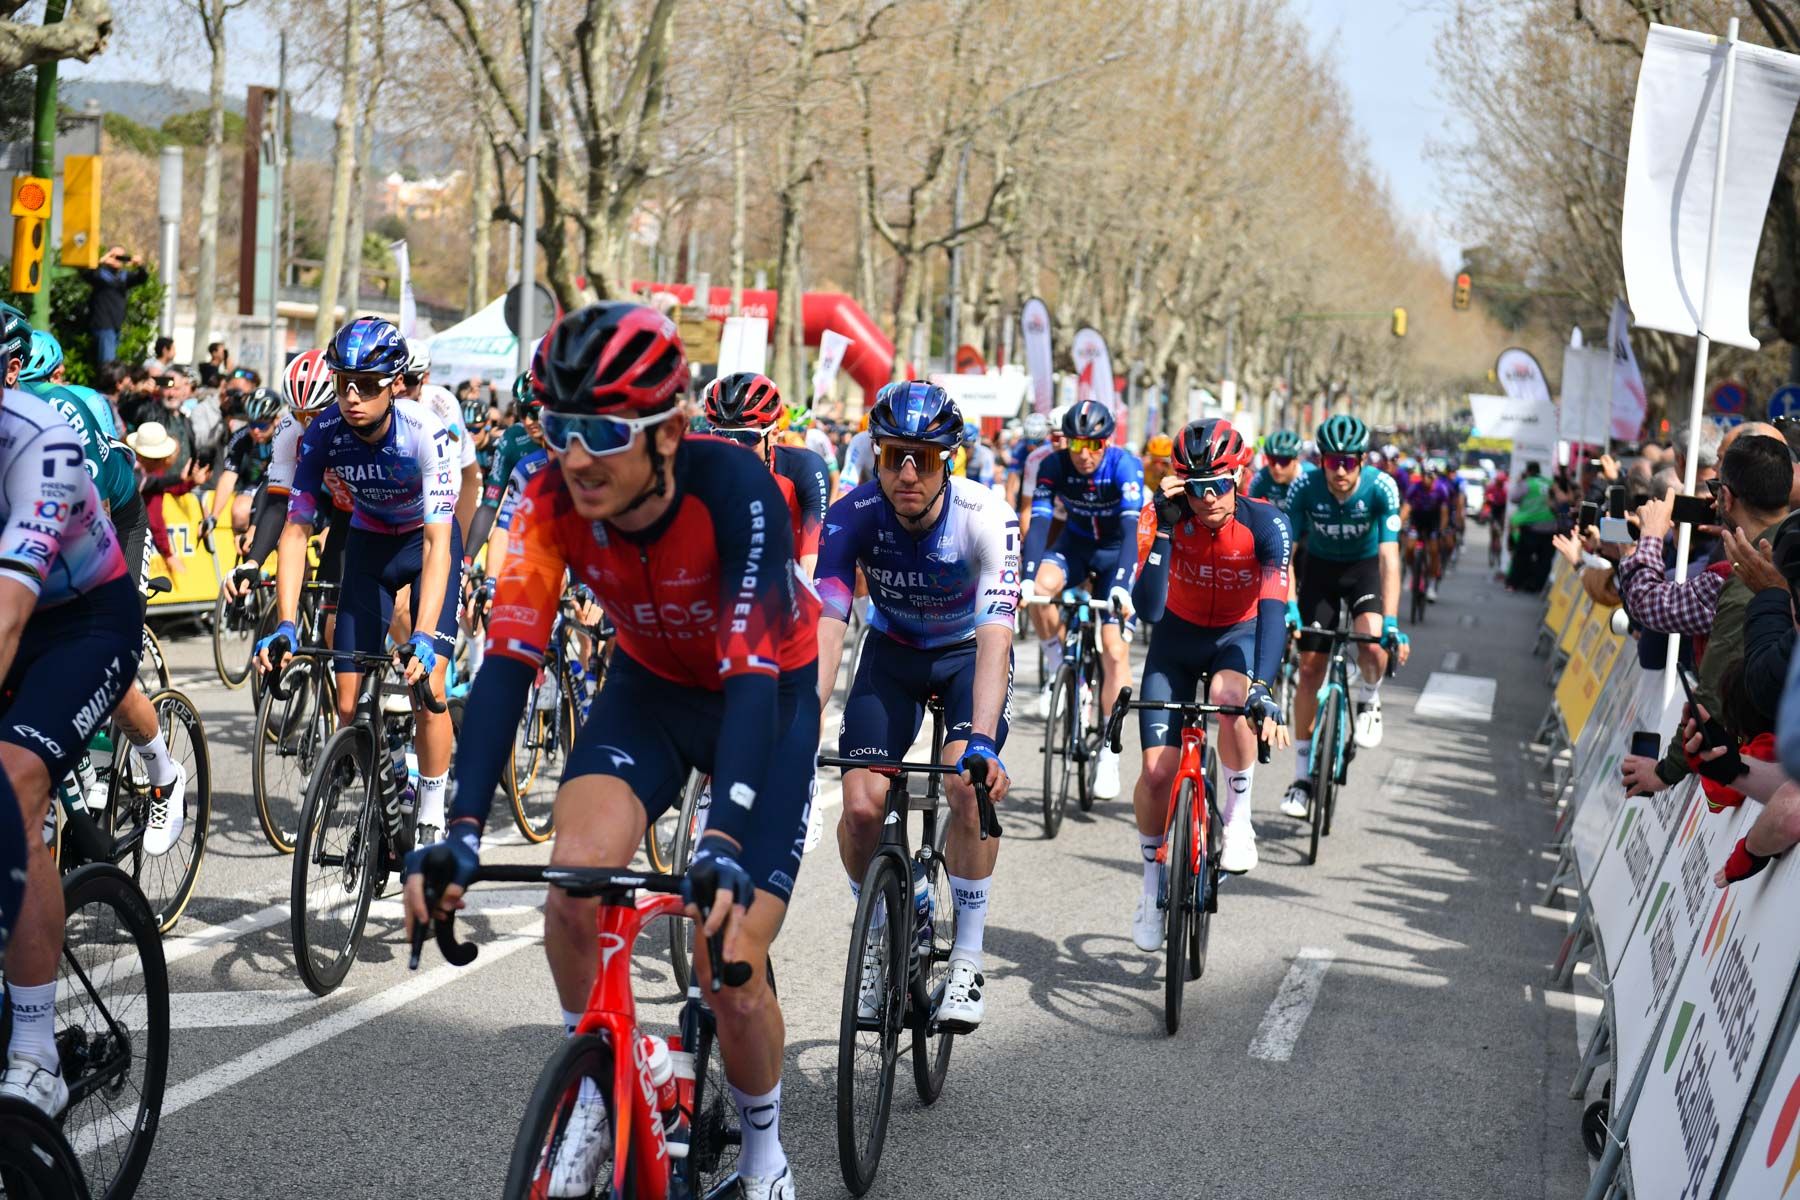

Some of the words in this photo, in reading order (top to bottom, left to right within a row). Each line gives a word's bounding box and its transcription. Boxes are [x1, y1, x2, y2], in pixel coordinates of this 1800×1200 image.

[49, 397, 90, 446] KERN
[362, 487, 408, 495] PREMIER
[1314, 521, 1370, 537] KERN
[1273, 517, 1290, 587] GRENADIER
[731, 500, 775, 633] GRENADIER
[867, 565, 928, 588] ISRAEL
[1176, 559, 1252, 582] INEOS
[909, 592, 963, 602] PREMIER
[912, 600, 944, 608] TECH
[72, 687, 109, 740] ISRAEL
[160, 698, 197, 730] CADEX
[850, 747, 889, 758] COGEAS
[955, 888, 984, 900] ISRAEL
[1710, 909, 1760, 1061] Loteries
[1733, 1009, 1760, 1083] de
[1675, 1012, 1720, 1200] Catalunya
